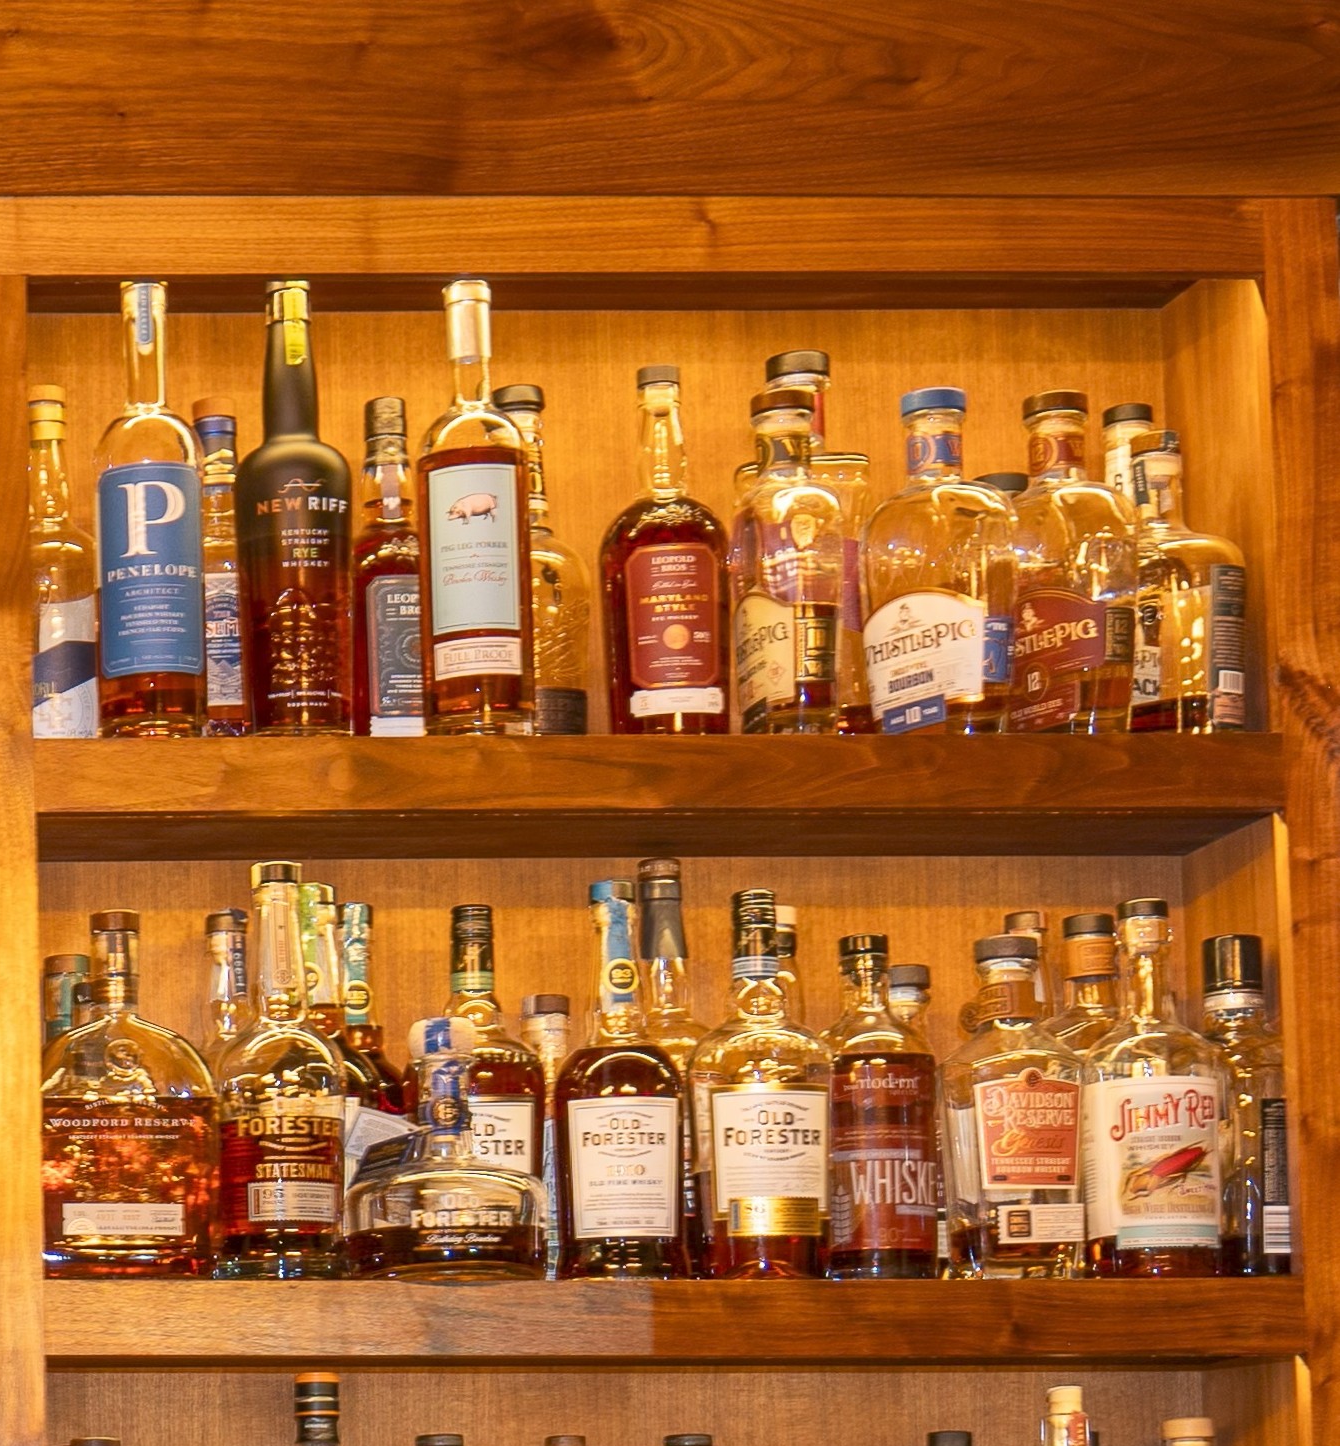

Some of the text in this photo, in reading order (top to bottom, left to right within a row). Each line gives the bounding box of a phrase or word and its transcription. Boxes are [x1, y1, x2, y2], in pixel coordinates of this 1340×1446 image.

[256, 496, 348, 515] NEW RIFF
[292, 547, 318, 559] RYE
[651, 555, 695, 565] LEOPOLD
[107, 564, 198, 582] PENELOPE
[661, 564, 687, 572] BROS
[639, 593, 708, 604] MARYLAND
[653, 602, 695, 613] STYLE
[1026, 672, 1041, 692] 12
[984, 1086, 1075, 1118] DAVIDSON
[49, 1115, 196, 1130] WOODFORD RESERVE
[608, 1117, 640, 1131] OLD
[757, 1109, 796, 1126] OLD
[1002, 1109, 1075, 1135] RESERVE
[1110, 1093, 1182, 1141] JIMMY
[237, 1115, 341, 1137] FORESTER
[582, 1132, 666, 1147] FORESTER
[723, 1127, 822, 1147] FORESTER
[991, 1129, 1064, 1156] Genesis
[255, 1163, 333, 1179] STATESMAN
[606, 1164, 646, 1176] 1910
[411, 1209, 513, 1228] FORESTER
